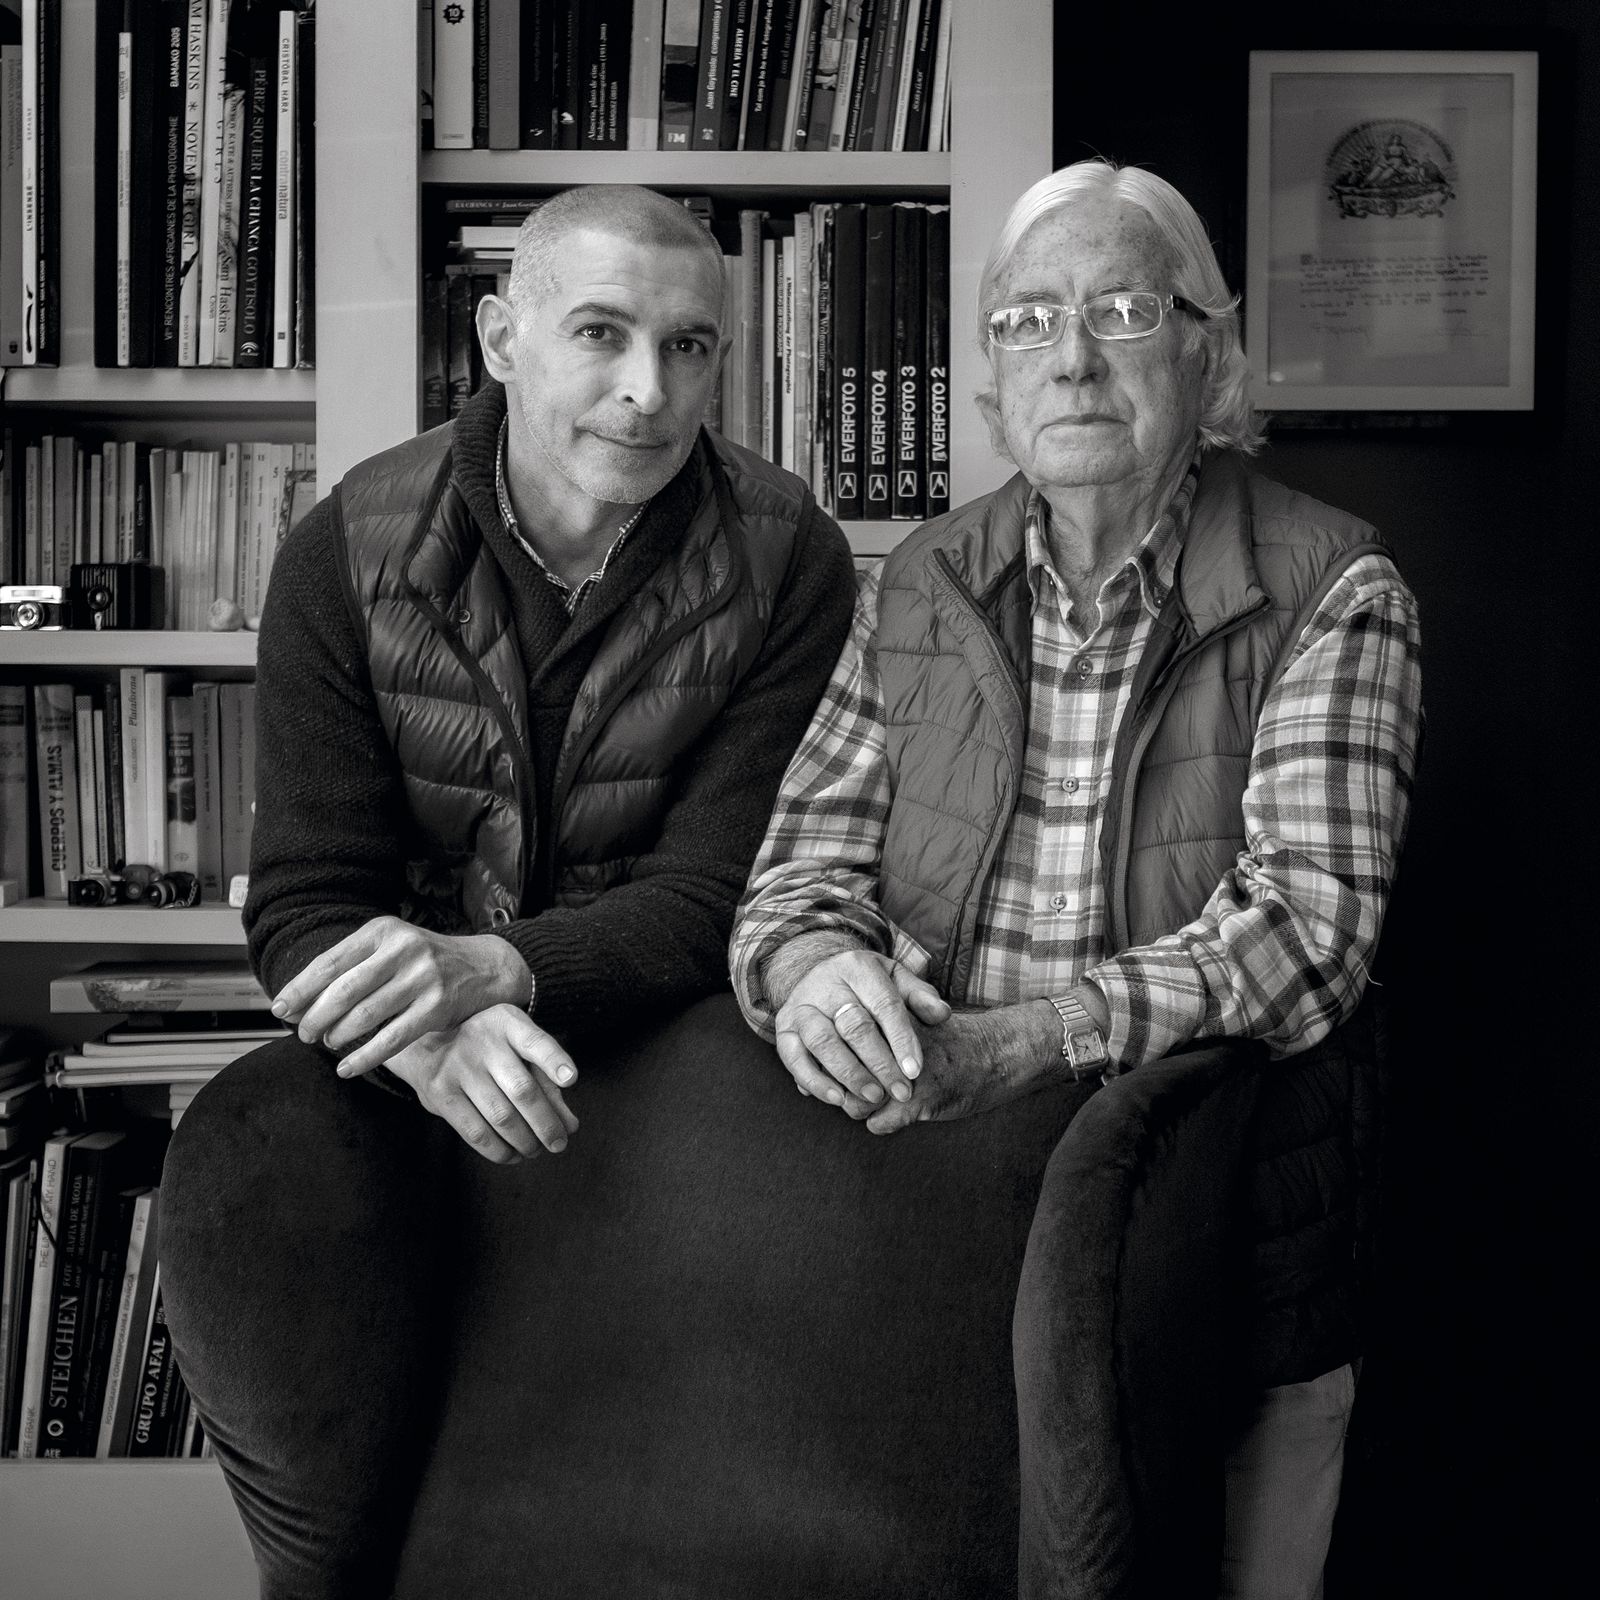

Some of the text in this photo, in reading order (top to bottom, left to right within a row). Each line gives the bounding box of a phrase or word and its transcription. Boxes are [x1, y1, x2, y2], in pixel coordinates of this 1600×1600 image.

[784, 0, 796, 21] fond
[169, 27, 181, 88] BAMAKO 2005
[187, 23, 202, 91] HASKINS
[704, 91, 714, 110] Juan
[709, 10, 722, 55] compromiso
[732, 28, 744, 62] ALMERÍA
[780, 50, 790, 59] el
[781, 60, 789, 75] con
[280, 37, 290, 114] CRISTÓBAL HARA
[729, 79, 739, 99] CINE
[731, 69, 740, 79] EL
[754, 103, 762, 113] Tal
[168, 116, 179, 184] PHOTOGRAPHIE
[168, 184, 178, 197] LA
[168, 198, 177, 211] DE
[182, 121, 199, 250] NOVEMBER GIRL
[242, 69, 269, 335] PÉREZ SIQUIER LA CHANCA GOYTISOLO
[278, 149, 290, 221] contranatura
[166, 213, 177, 265] AFRICAINES
[164, 266, 175, 326] RENCONTRES
[218, 254, 234, 334] Sam Haskins
[818, 280, 830, 372] Michael Wolgensinger
[841, 366, 857, 463] EVERFOTO 5
[871, 369, 888, 465] EVERFOTO 4
[900, 366, 917, 461] EVERFOTO 3
[930, 367, 948, 462] EVERFOTO 2
[128, 675, 138, 728] Plataforma
[46, 745, 64, 792] ALMAS
[48, 795, 64, 805] Y
[49, 807, 67, 872] CUERPOS
[45, 1190, 54, 1205] MY
[47, 1159, 57, 1188] HAND
[70, 1174, 83, 1206] MODA
[41, 1221, 52, 1249] LINS
[69, 1208, 79, 1223] DE
[38, 1249, 49, 1269] THE
[49, 1294, 78, 1409] STEICHEN
[135, 1336, 167, 1445] GRUPO AFAL
[22, 1441, 33, 1458] ERT
